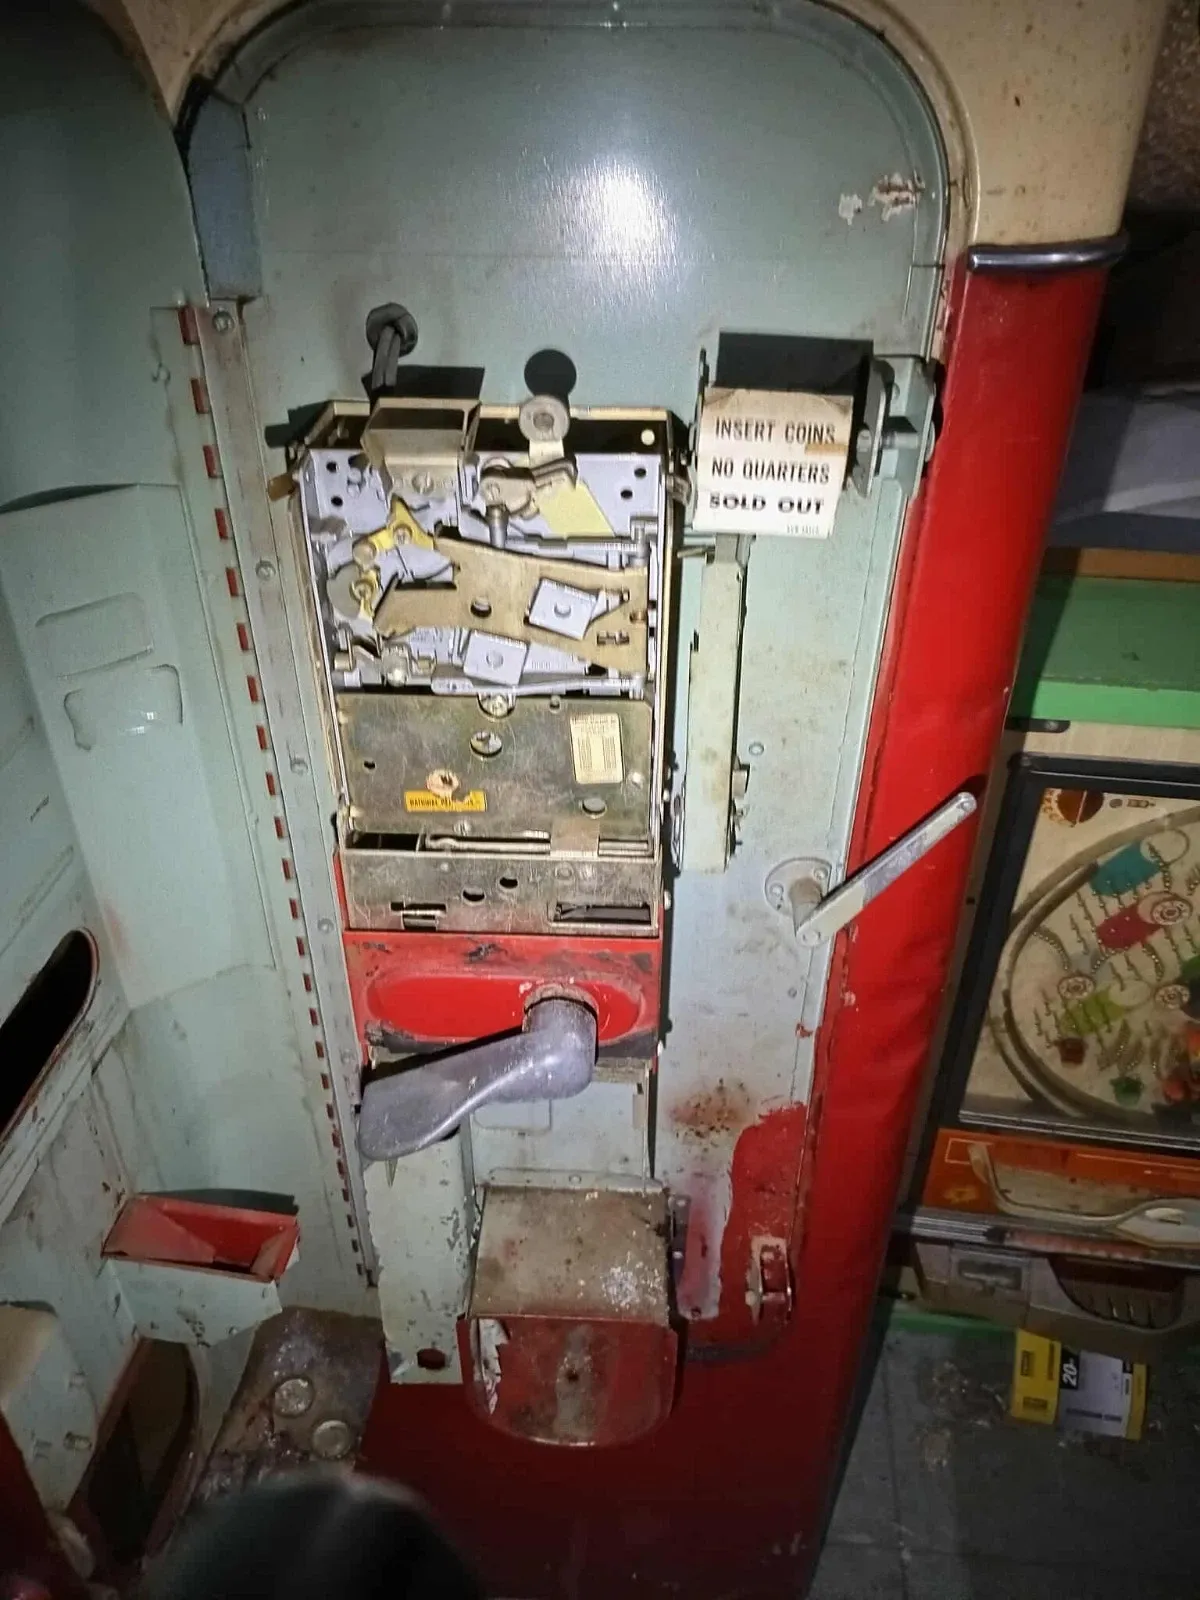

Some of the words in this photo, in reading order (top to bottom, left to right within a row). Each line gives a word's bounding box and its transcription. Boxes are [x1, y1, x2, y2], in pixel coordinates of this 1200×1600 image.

[715, 416, 776, 443] INSERT
[785, 420, 836, 445] COINS
[711, 456, 734, 479] NO
[742, 460, 830, 485] QUARTERS
[709, 491, 767, 512] SOLD
[777, 496, 824, 515] OUT
